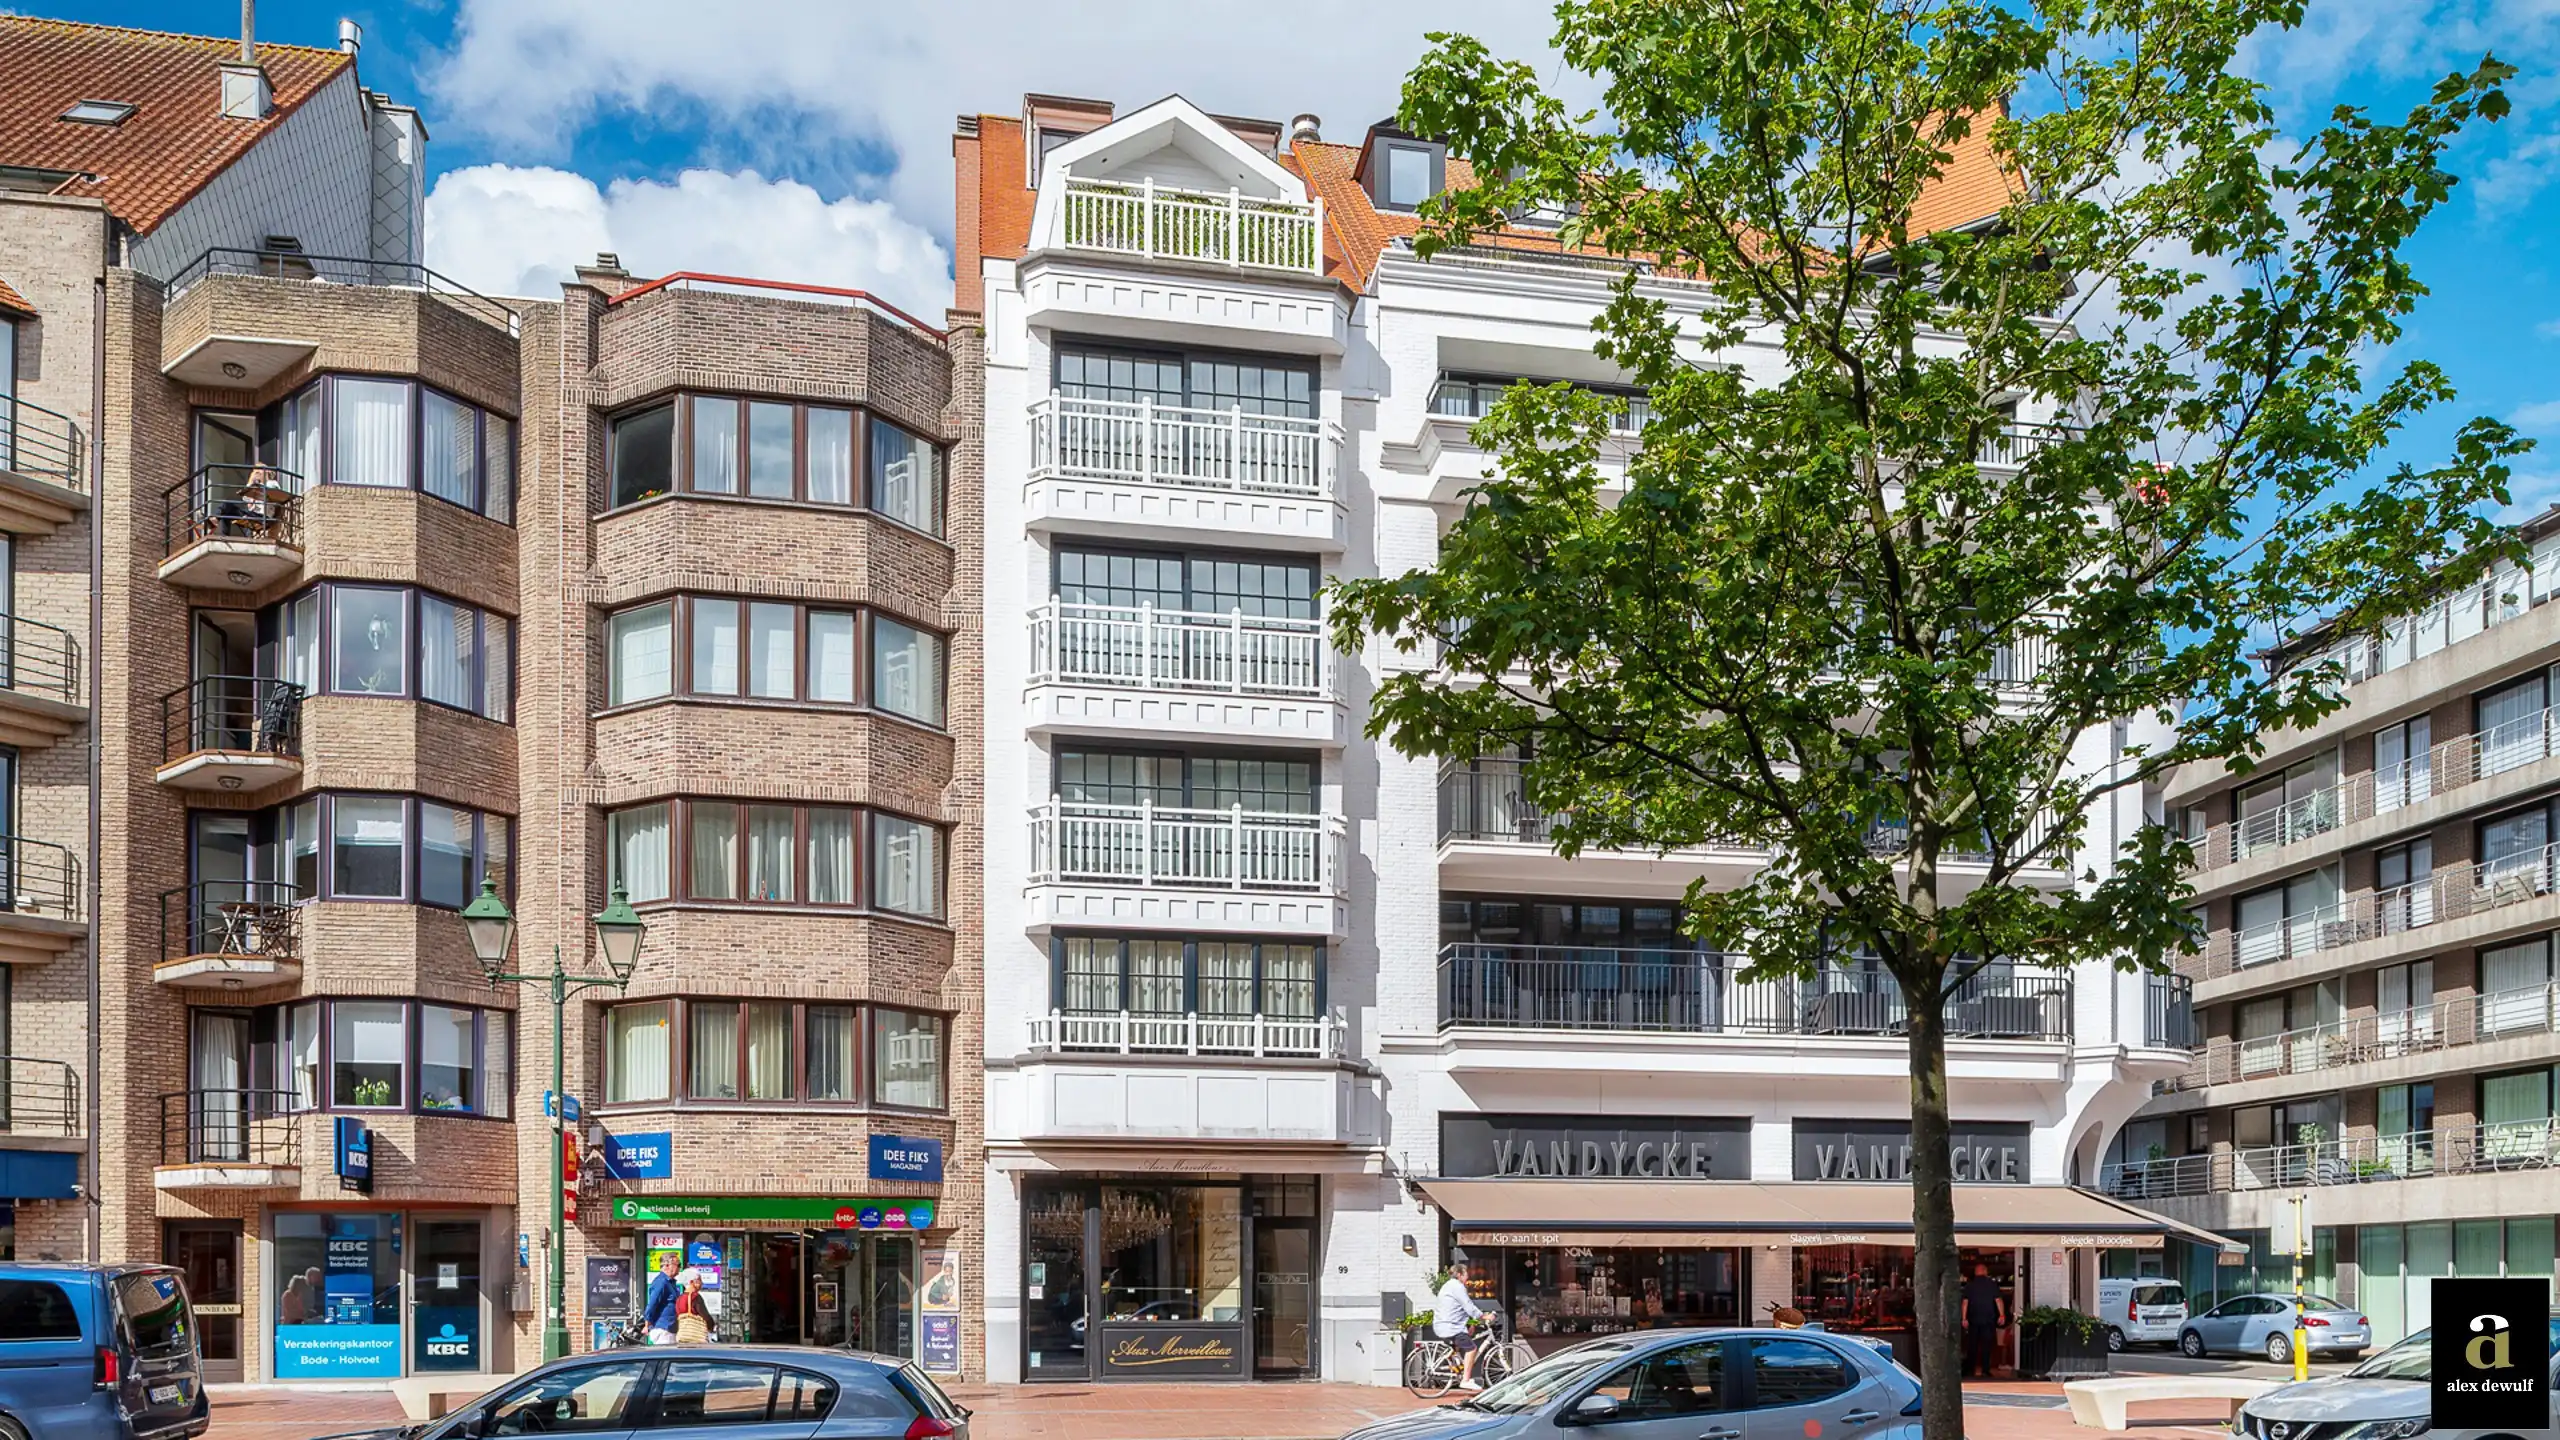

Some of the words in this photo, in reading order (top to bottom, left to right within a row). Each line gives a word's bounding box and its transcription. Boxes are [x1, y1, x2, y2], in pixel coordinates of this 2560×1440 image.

[617, 1147, 637, 1160] IDEE
[640, 1146, 658, 1160] FIKS
[883, 1149, 905, 1161] IDEE
[908, 1151, 929, 1163] FIKS
[1493, 1139, 1706, 1177] VANDYCKE
[890, 1162, 923, 1171] MAGAZINES
[1816, 1144, 2016, 1181] VANDCKE
[640, 1204, 682, 1214] nationale
[684, 1204, 710, 1216] loterij
[652, 1235, 678, 1247] lotto
[1492, 1232, 1508, 1245] Kip
[1542, 1232, 1560, 1246] spit
[1790, 1233, 1822, 1246] Slagerij
[2060, 1235, 2094, 1247] Belegde
[2096, 1235, 2134, 1247] Broodjes
[329, 1241, 369, 1252] KBC
[1338, 1265, 1349, 1274] 99
[283, 1339, 394, 1351] Verzekeringskantoor
[427, 1343, 469, 1356] KBC
[1111, 1335, 1149, 1357] Aux
[1151, 1335, 1233, 1357] Merveilleux
[300, 1355, 329, 1365] Bode
[339, 1355, 380, 1365] Holvoet
